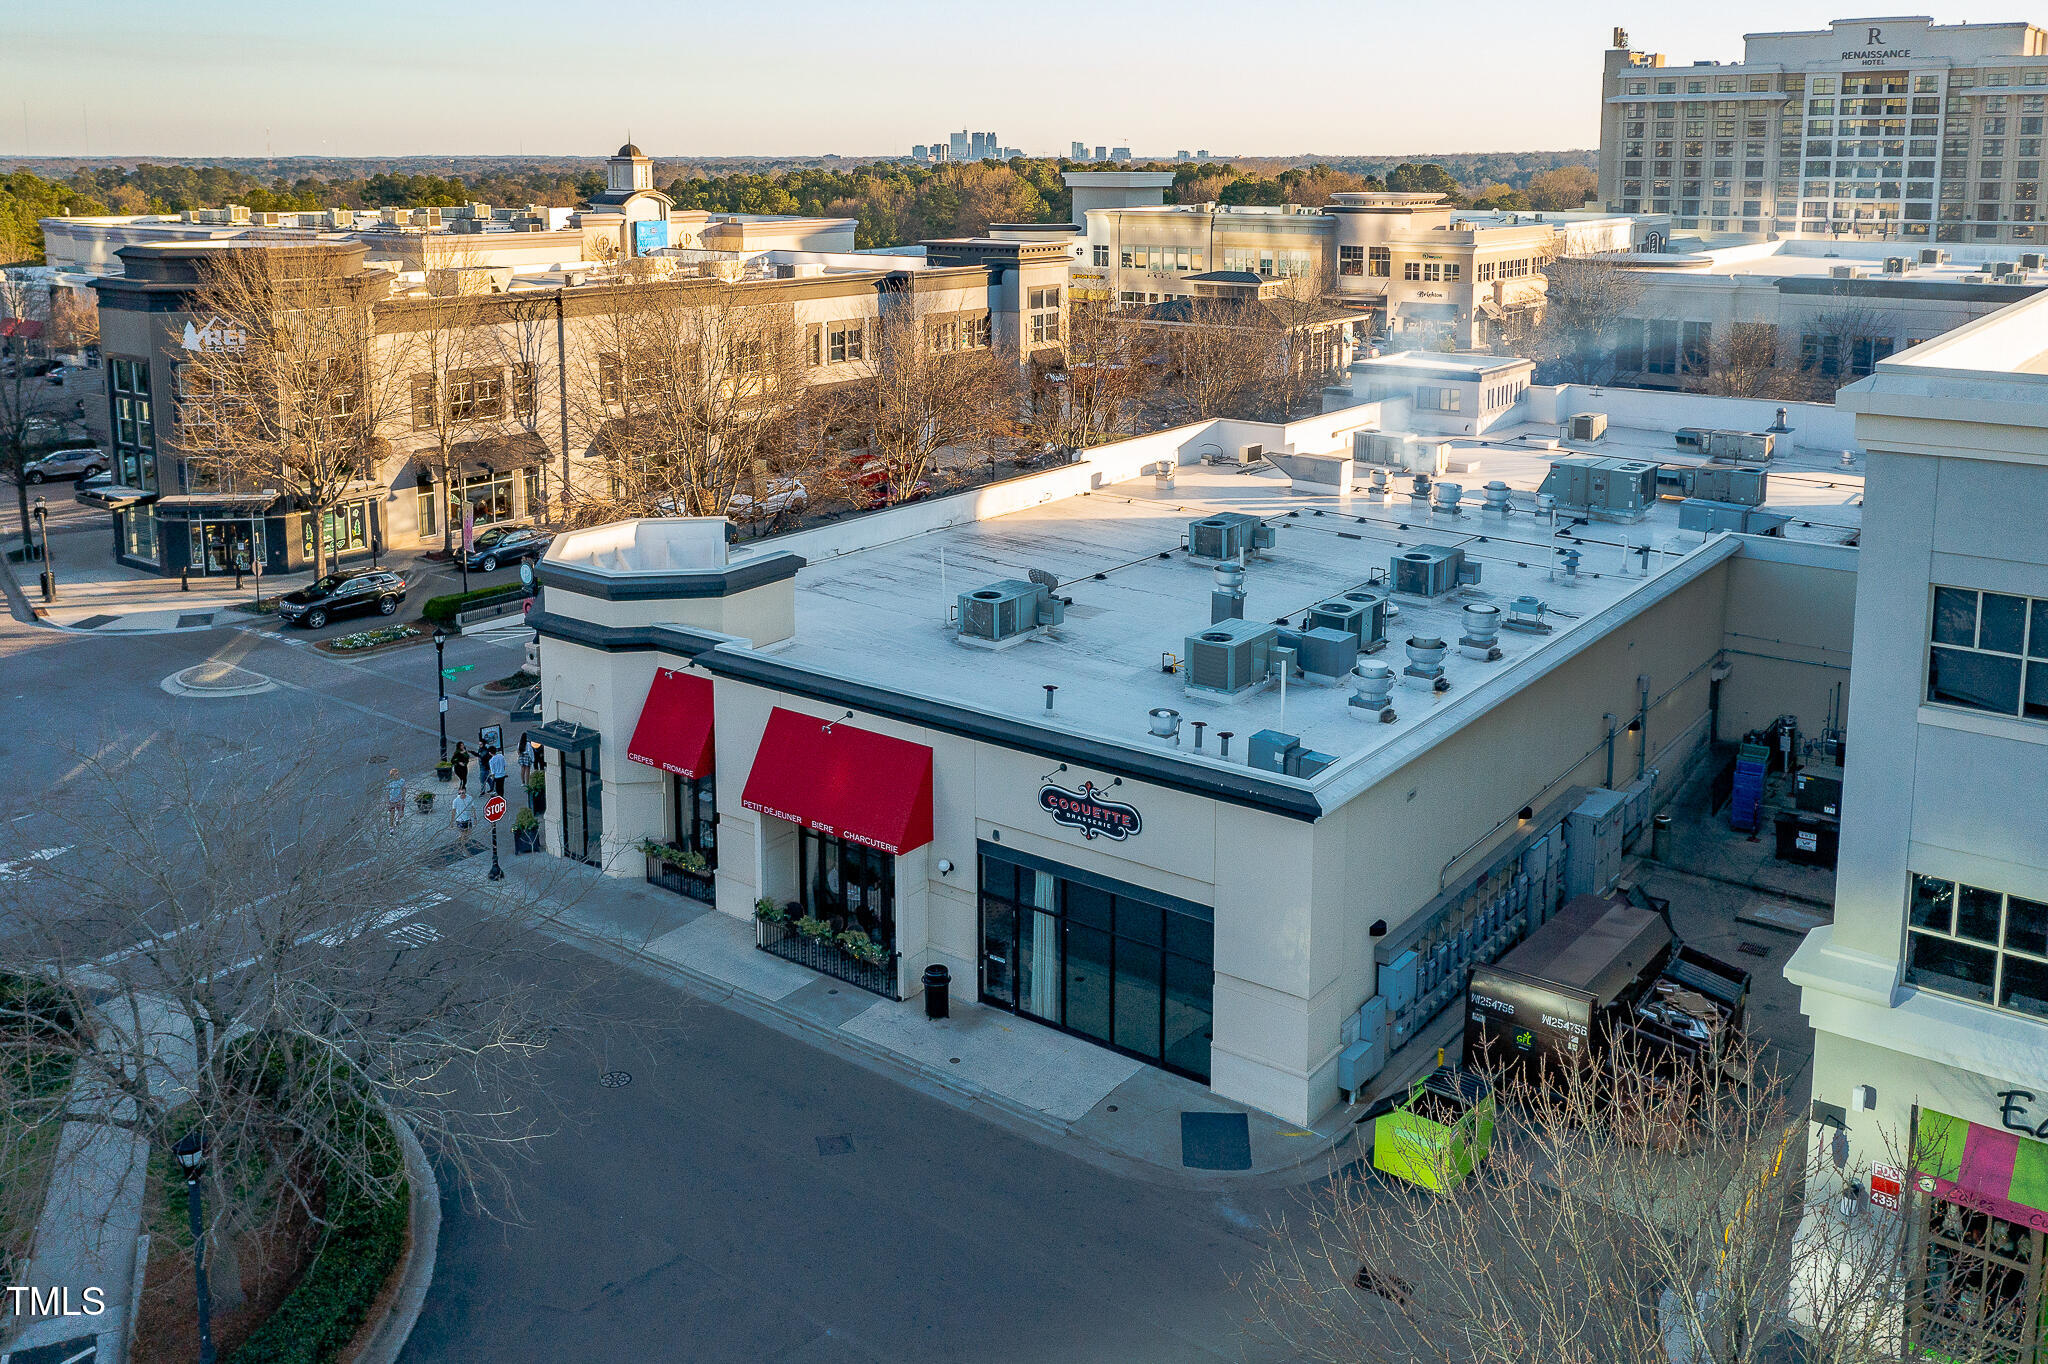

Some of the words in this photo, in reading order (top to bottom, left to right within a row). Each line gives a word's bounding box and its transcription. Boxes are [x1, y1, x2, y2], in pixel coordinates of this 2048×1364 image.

[1867, 28, 1887, 45] R
[1842, 49, 1911, 60] RENAISSANCE
[204, 329, 247, 346] REI
[662, 762, 694, 778] FROMAGE
[486, 801, 505, 817] STOP
[1047, 795, 1132, 828] COQUETTE
[743, 800, 763, 812] PETIT
[843, 830, 899, 854] CHARCUTERIE
[1066, 812, 1111, 829] BRASSERIE
[1516, 1033, 1532, 1046] GFL
[1874, 1162, 1899, 1180] FDC
[1871, 1192, 1898, 1209] 4351
